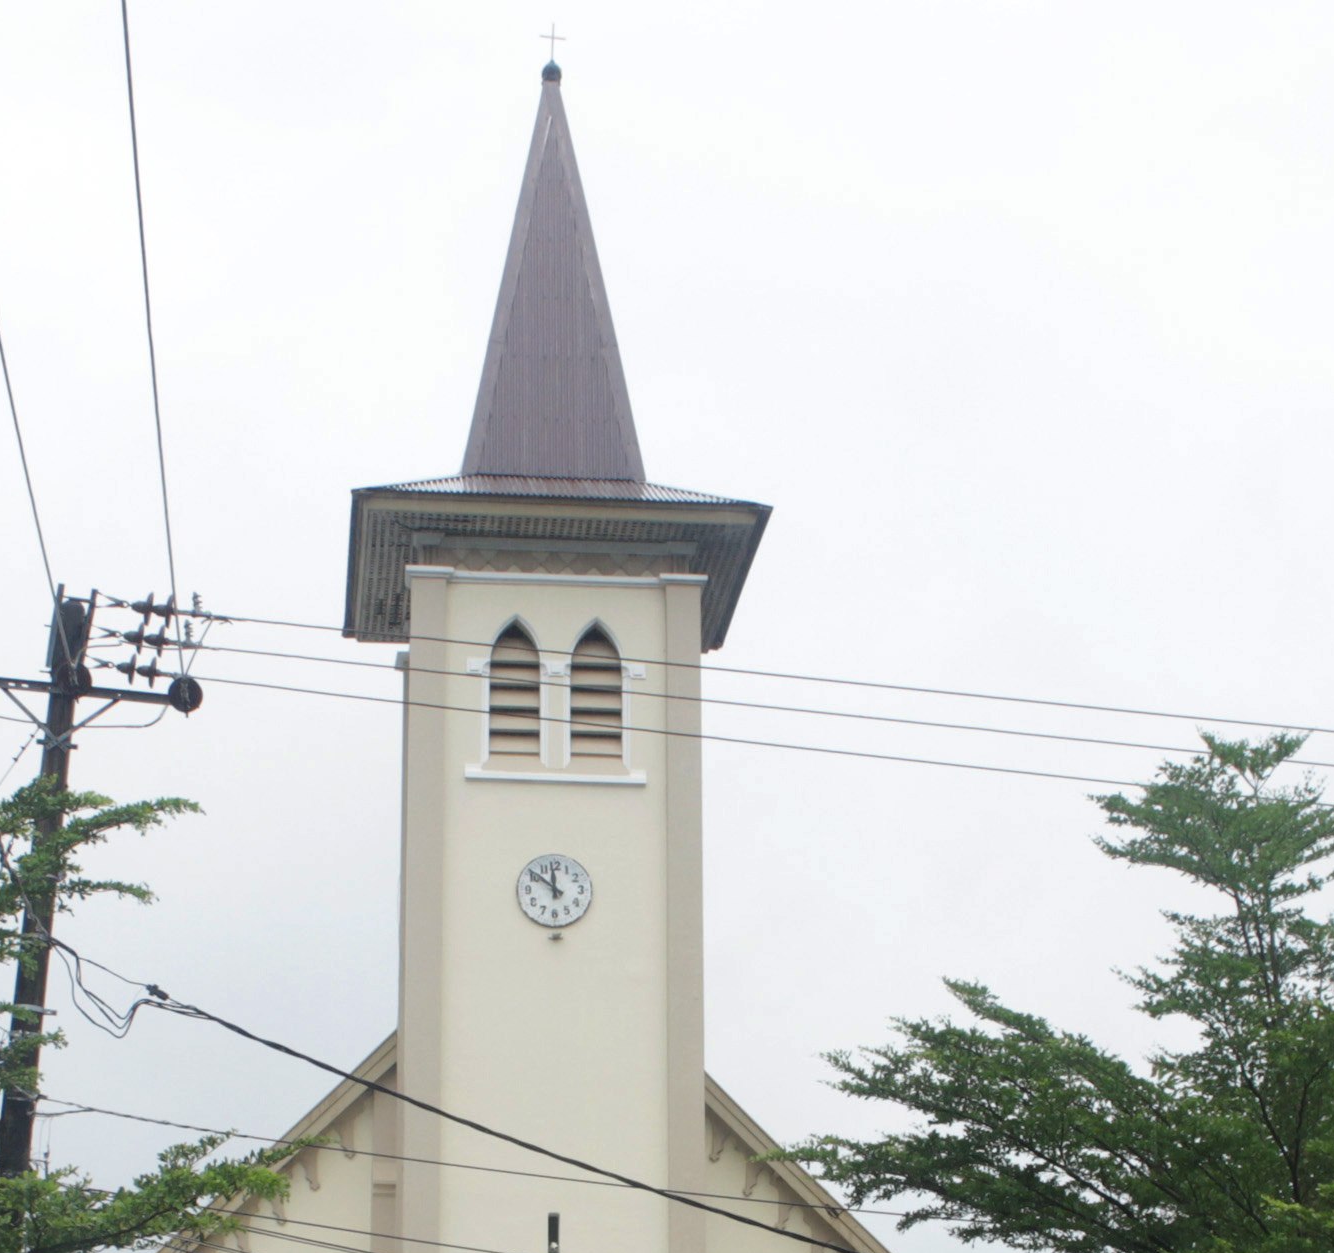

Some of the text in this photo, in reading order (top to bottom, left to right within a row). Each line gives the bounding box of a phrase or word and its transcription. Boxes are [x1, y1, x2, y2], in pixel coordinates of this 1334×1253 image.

[540, 864, 548, 874] 11
[550, 861, 561, 871] 12
[565, 865, 569, 875] 1
[572, 873, 579, 882] 2
[525, 885, 531, 894] 9
[578, 885, 584, 894] 3
[531, 897, 536, 907] 8
[573, 898, 579, 907] 4
[540, 905, 546, 915] 7
[552, 909, 558, 918] 6
[564, 906, 570, 915] 5
